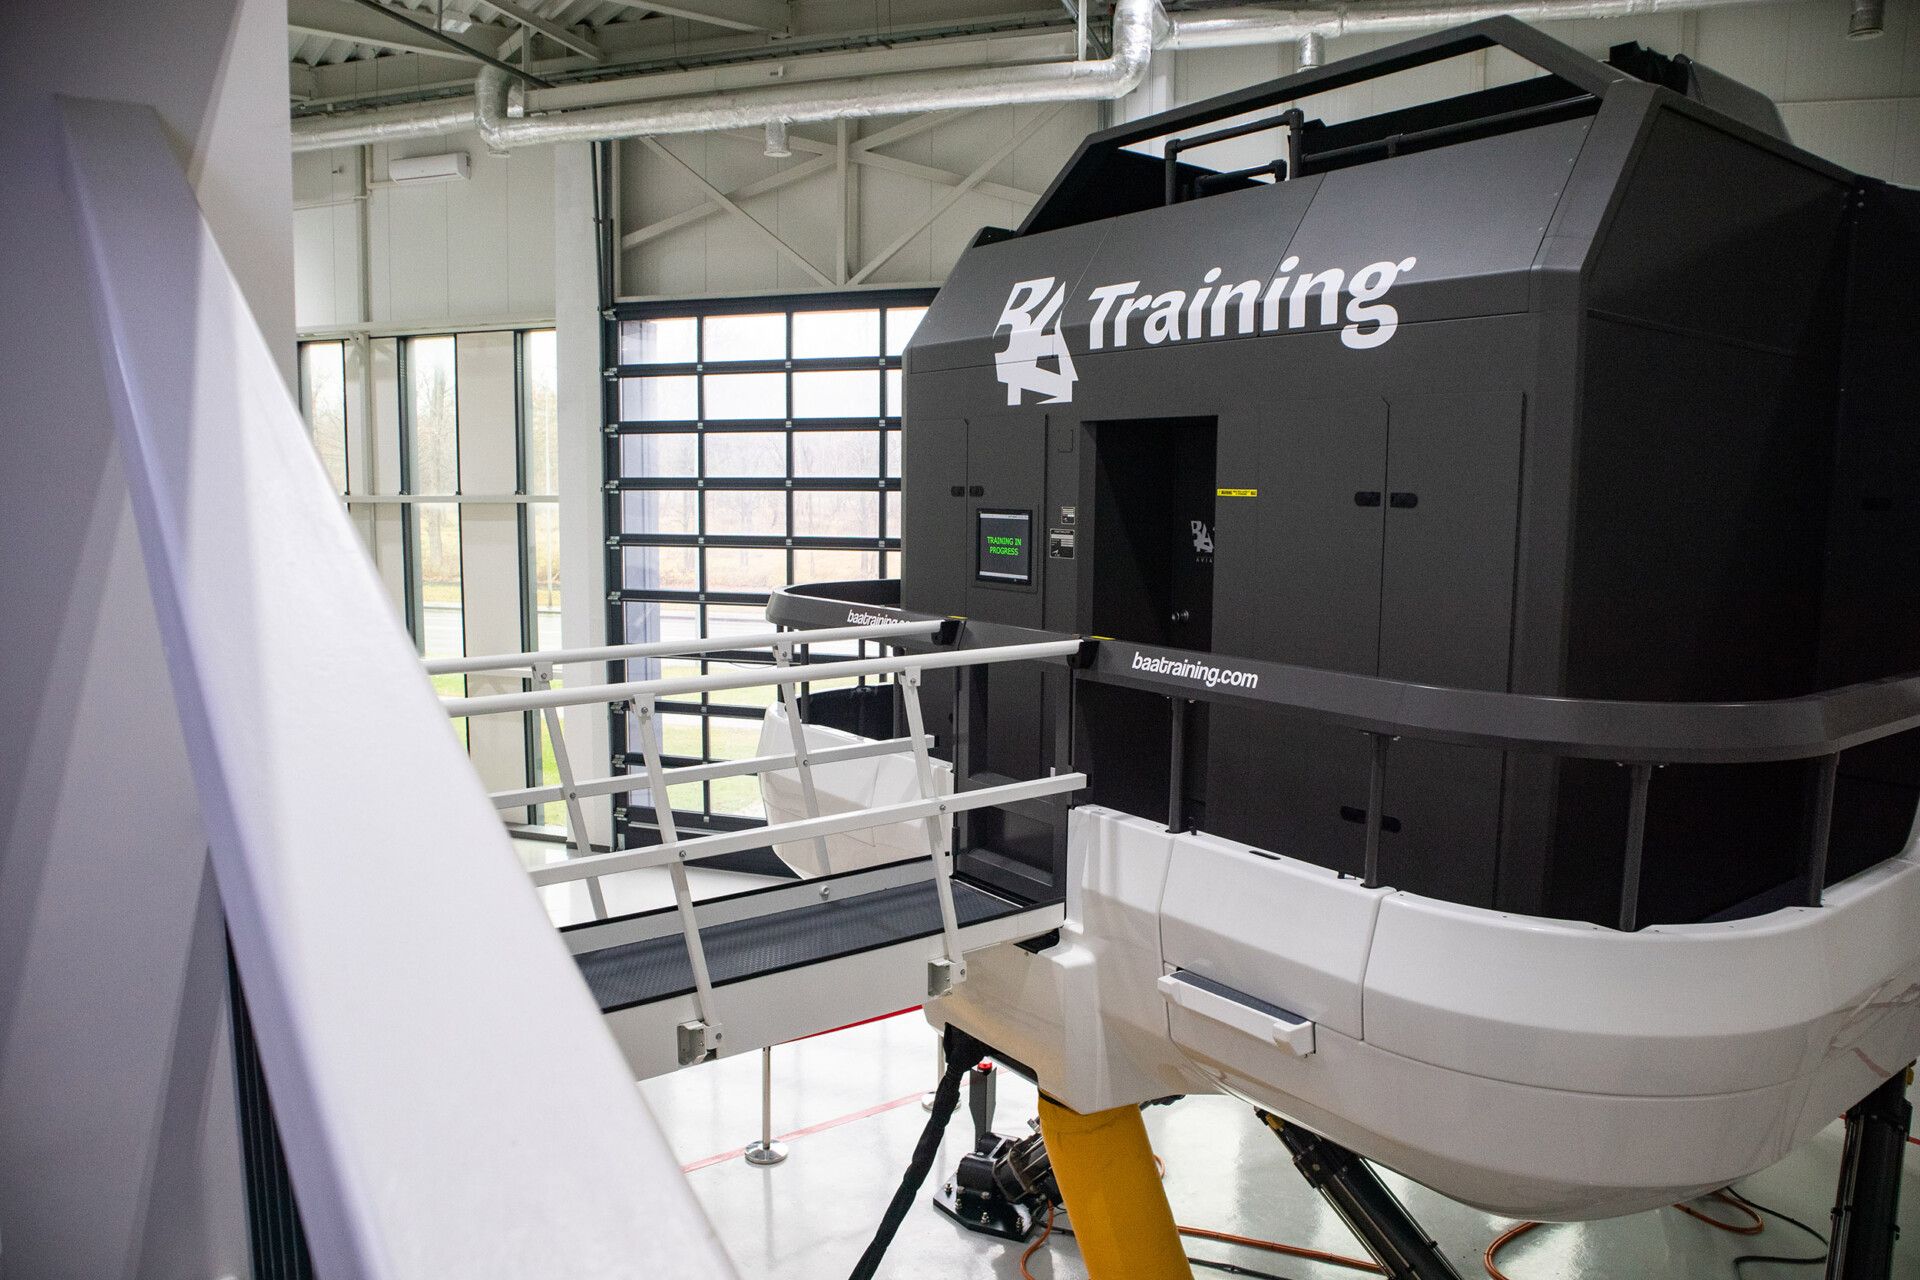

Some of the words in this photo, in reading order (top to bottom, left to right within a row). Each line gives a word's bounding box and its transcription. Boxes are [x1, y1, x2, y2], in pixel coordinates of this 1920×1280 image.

[1088, 255, 1417, 350] Training
[987, 536, 1014, 546] TRAINING
[1015, 538, 1022, 546] IN
[989, 546, 1019, 556] PROGRESS
[846, 609, 912, 627] baatrainin
[1131, 651, 1259, 689] baatraining.com
